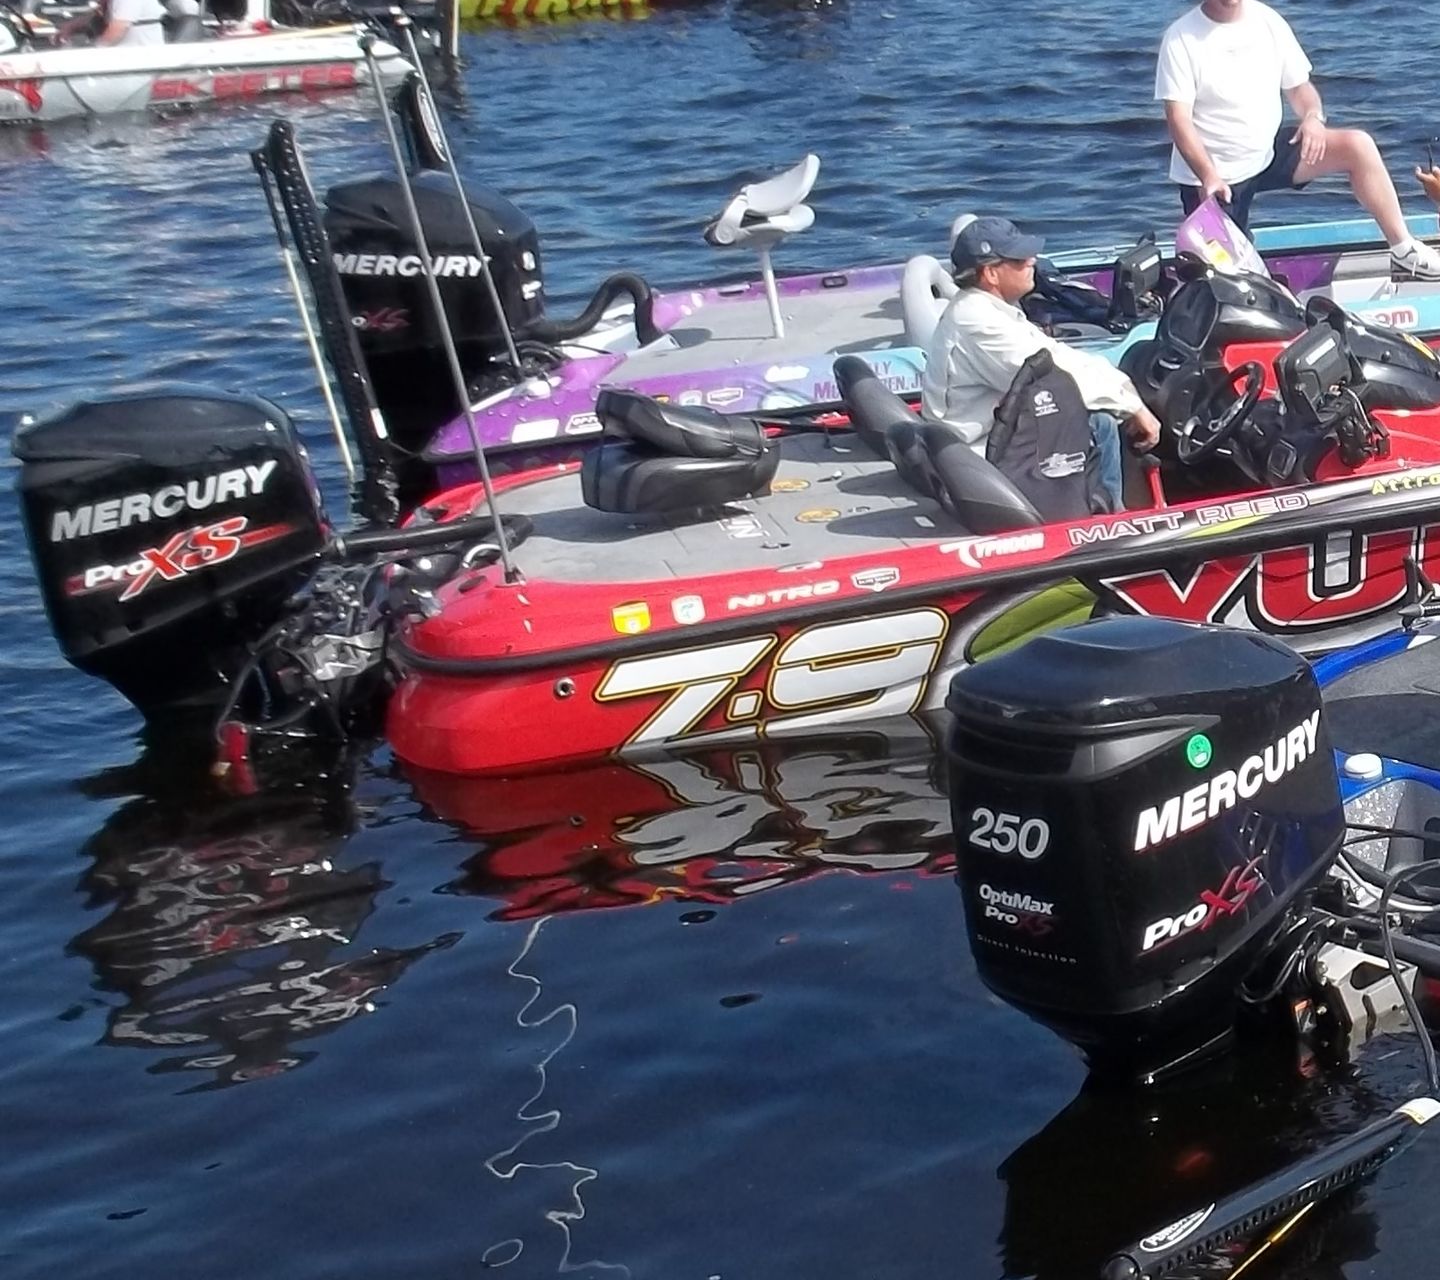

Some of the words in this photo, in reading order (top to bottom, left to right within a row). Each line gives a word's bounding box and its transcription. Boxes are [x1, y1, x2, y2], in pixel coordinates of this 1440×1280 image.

[332, 253, 493, 277] MERCURY
[51, 459, 279, 543] MERCURY
[1067, 511, 1185, 547] MATT
[1198, 491, 1309, 526] REED
[727, 579, 840, 610] NITRO
[1133, 708, 1321, 852] MERCURY
[969, 806, 1050, 860] 250
[979, 883, 1054, 916] OptiMax
